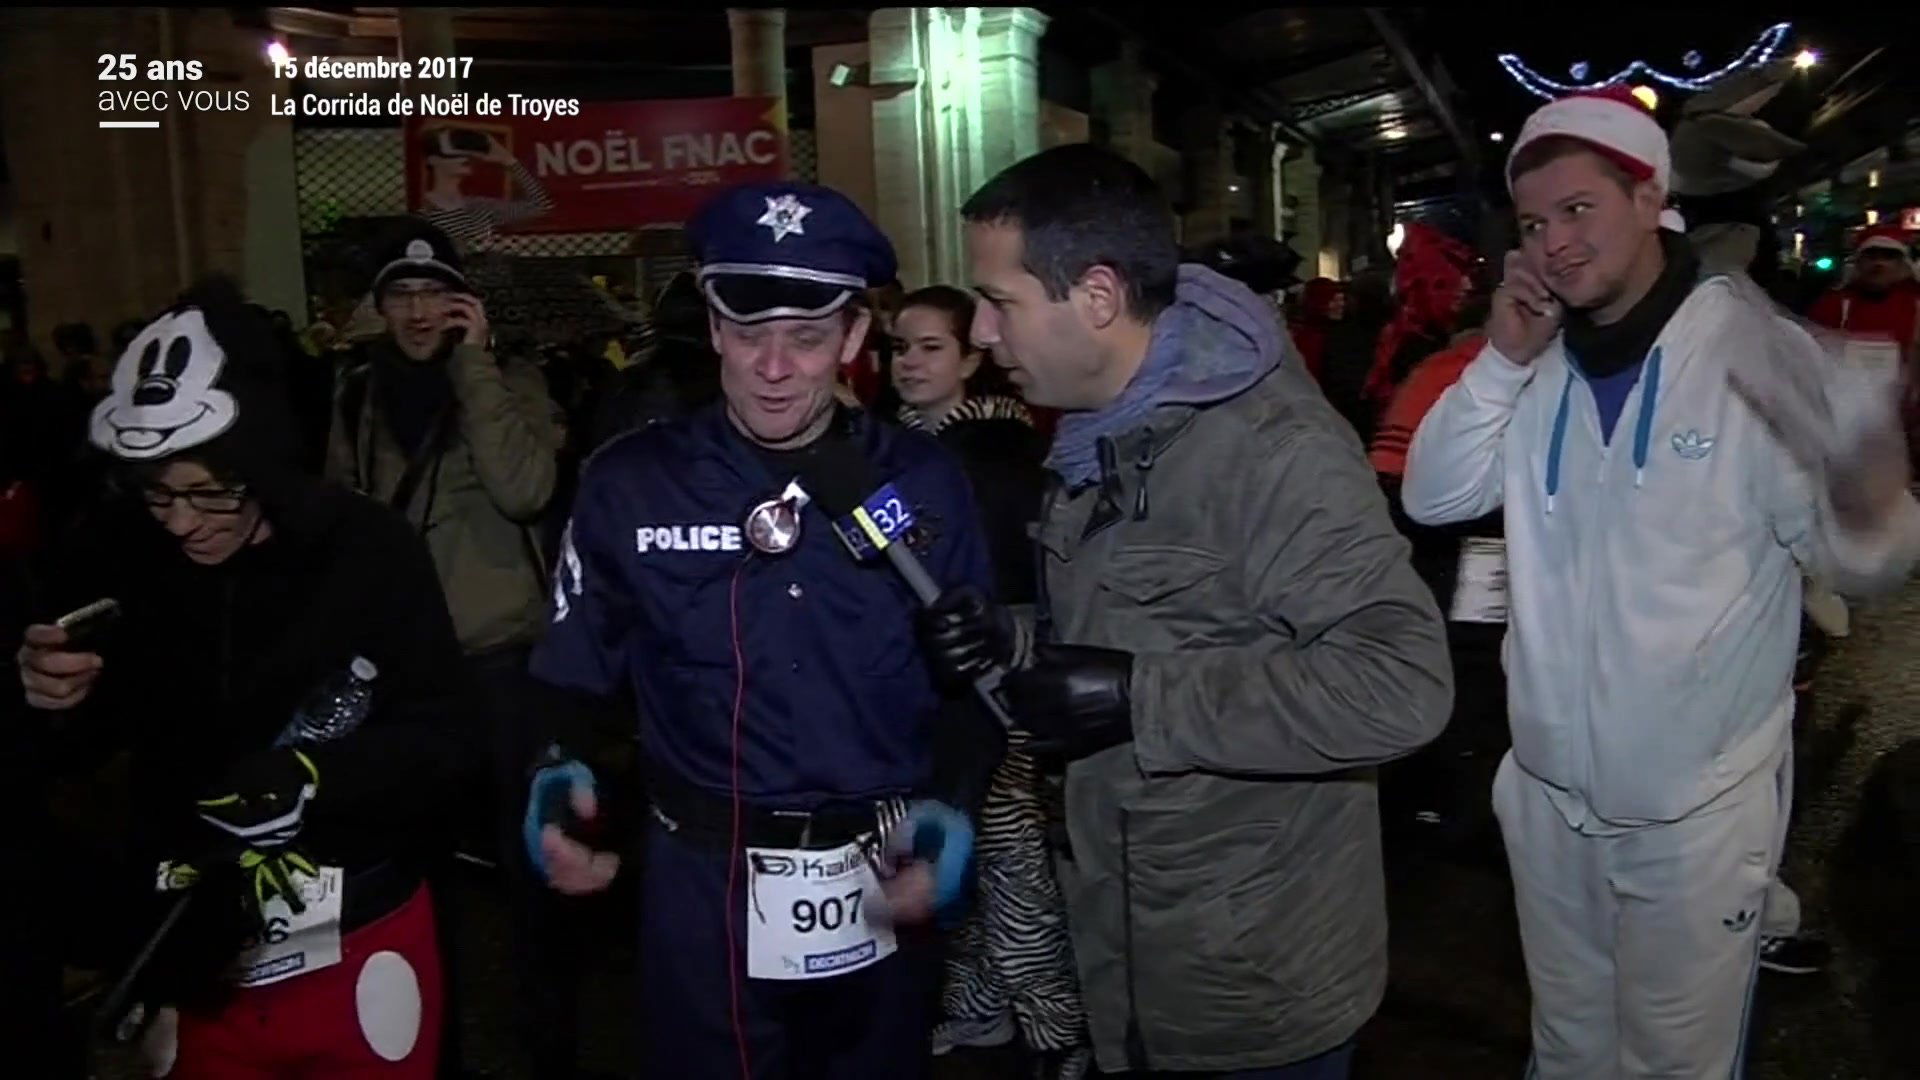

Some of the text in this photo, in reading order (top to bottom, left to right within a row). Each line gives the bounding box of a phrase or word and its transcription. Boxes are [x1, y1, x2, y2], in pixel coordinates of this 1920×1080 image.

[535, 129, 776, 178] NOËL FNAC
[872, 497, 911, 534] 32
[636, 525, 742, 553] POLICE
[791, 887, 865, 934] 907
